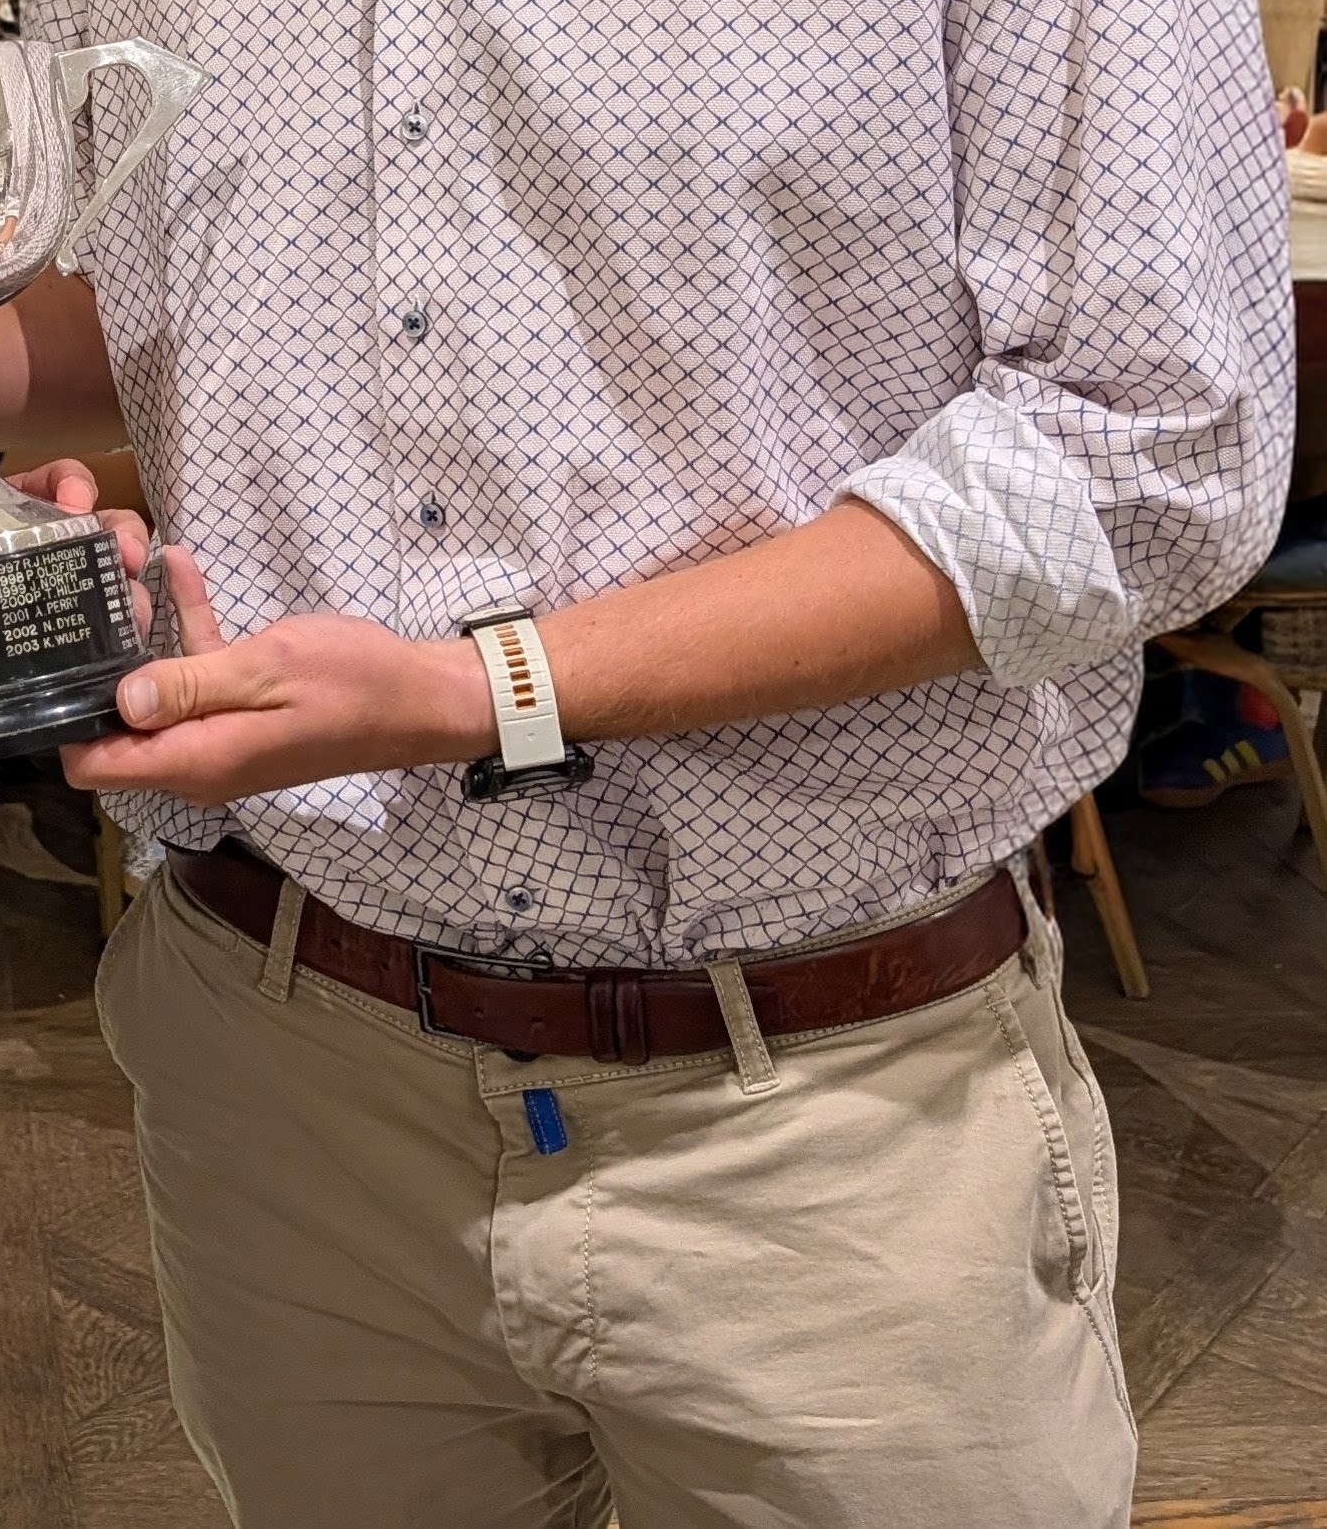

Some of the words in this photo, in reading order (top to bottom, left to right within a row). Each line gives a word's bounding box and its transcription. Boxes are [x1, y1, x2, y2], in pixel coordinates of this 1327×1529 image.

[23, 546, 86, 569] R.J.HARDING
[29, 572, 78, 592] J.NORTH
[0, 594, 34, 610] 2000
[2, 608, 30, 626] 2001
[2, 624, 38, 642] 2002
[5, 639, 40, 658] 2003
